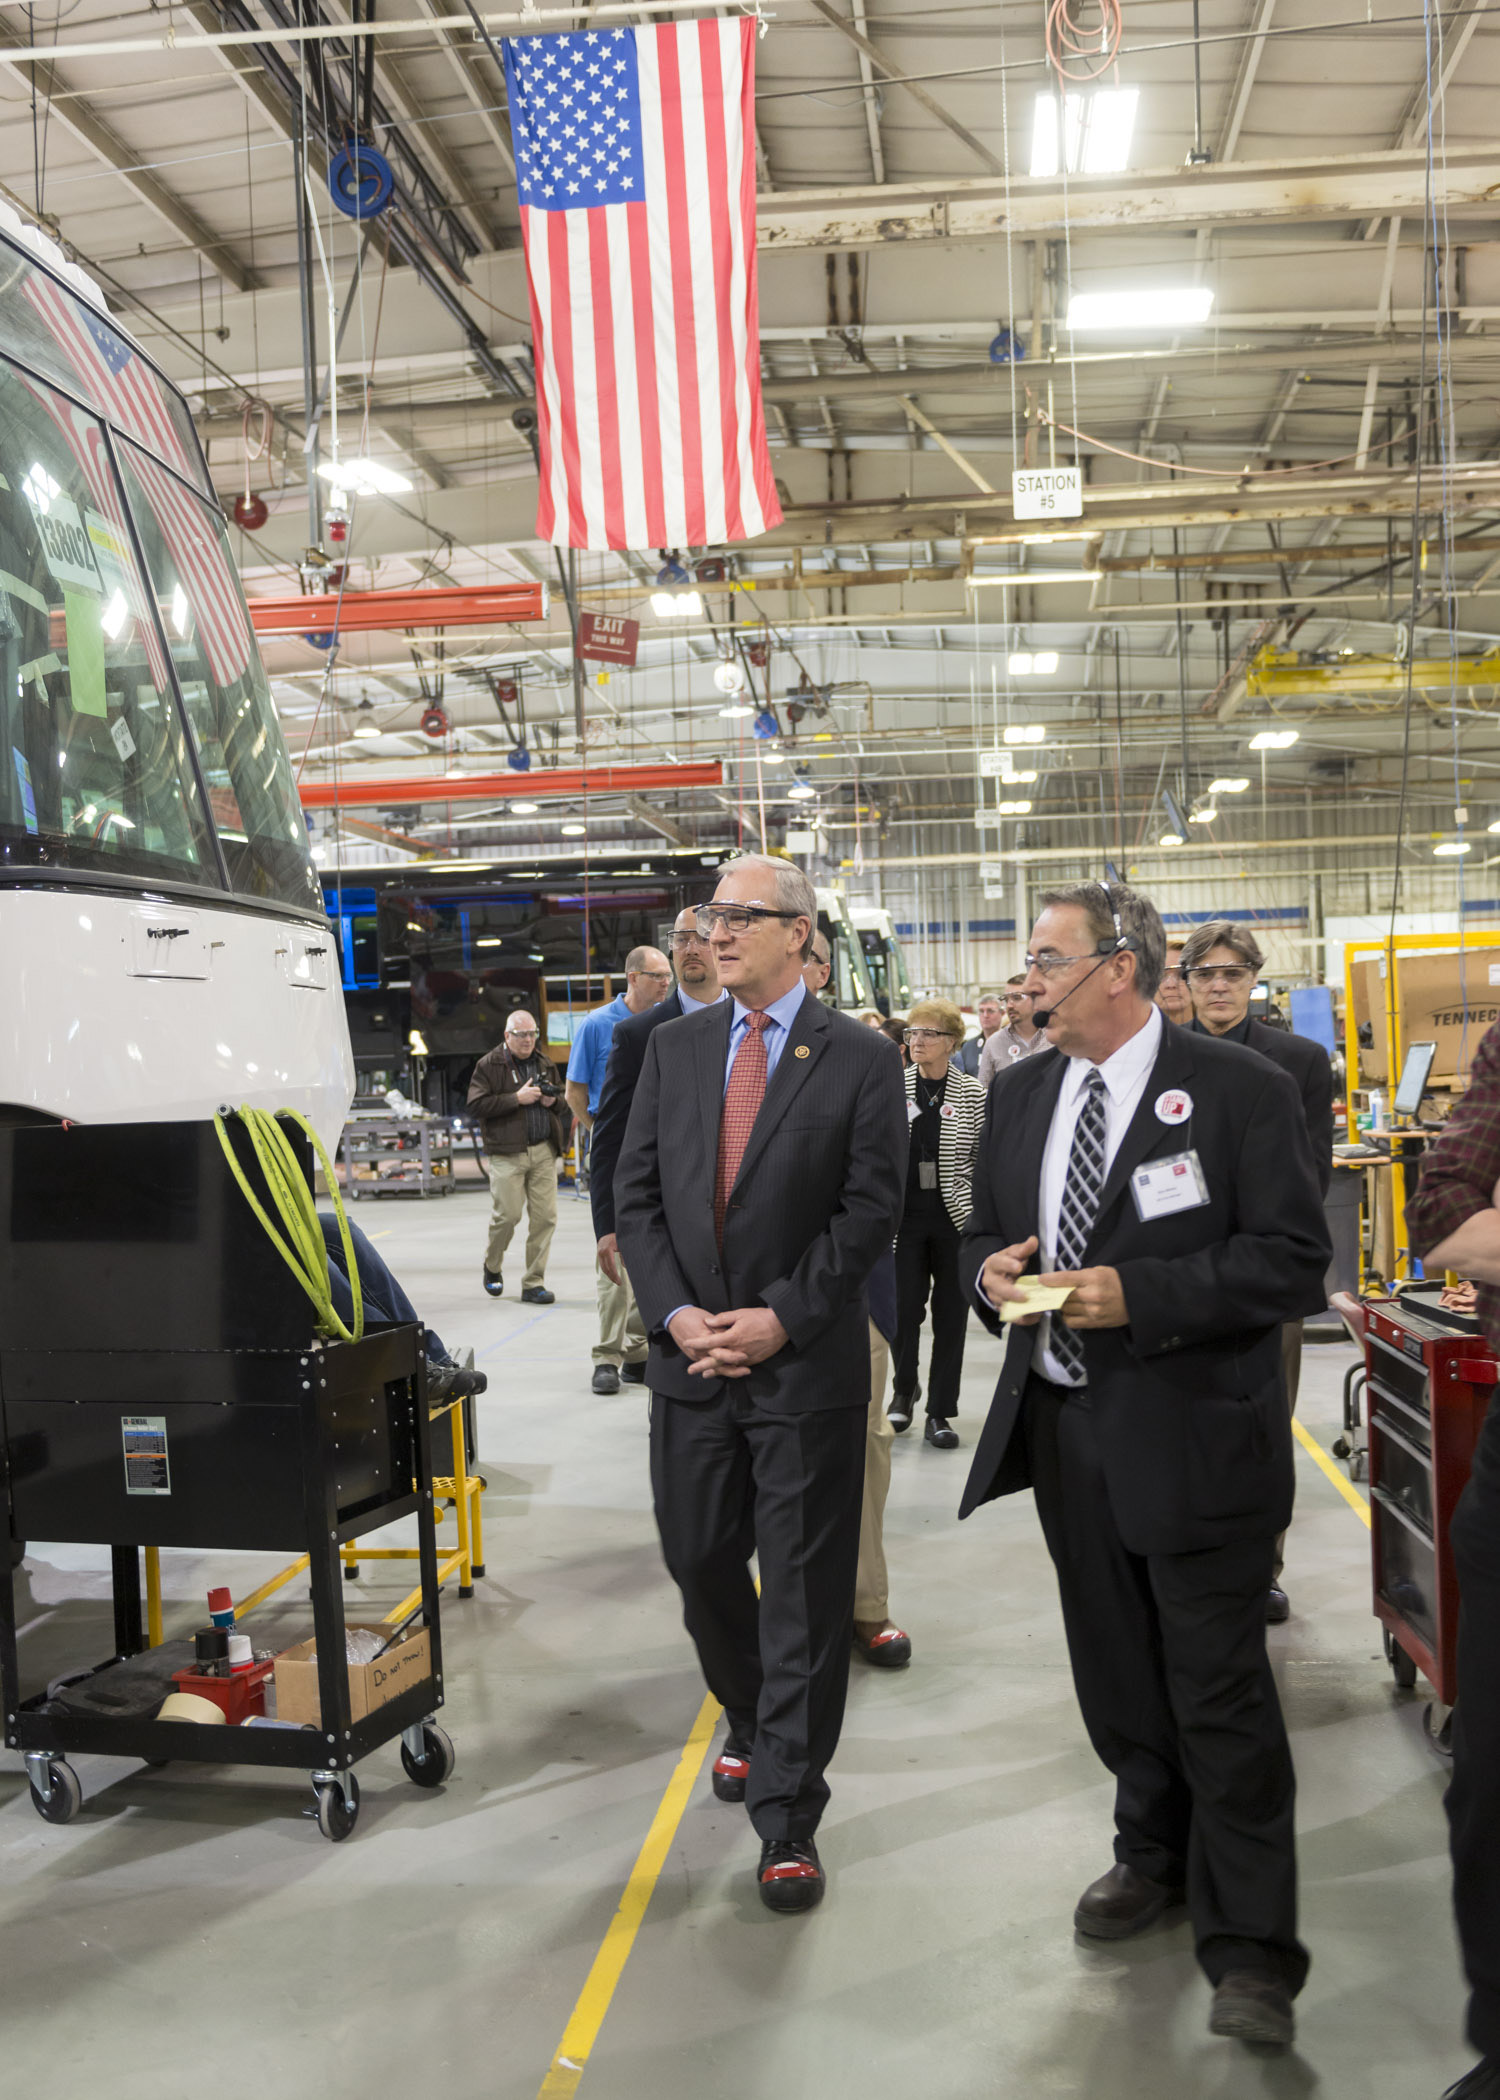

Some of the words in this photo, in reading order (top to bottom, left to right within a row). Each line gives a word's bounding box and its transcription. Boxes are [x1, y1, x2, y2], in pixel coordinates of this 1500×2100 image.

[1018, 475, 1076, 492] STATION
[1041, 495, 1055, 509] #5
[35, 513, 96, 572] 13802
[594, 616, 626, 634] EXIT
[591, 634, 607, 644] THIS
[610, 636, 626, 646] WAY
[1432, 1009, 1498, 1027] TENNEC
[373, 1669, 387, 1688] Do
